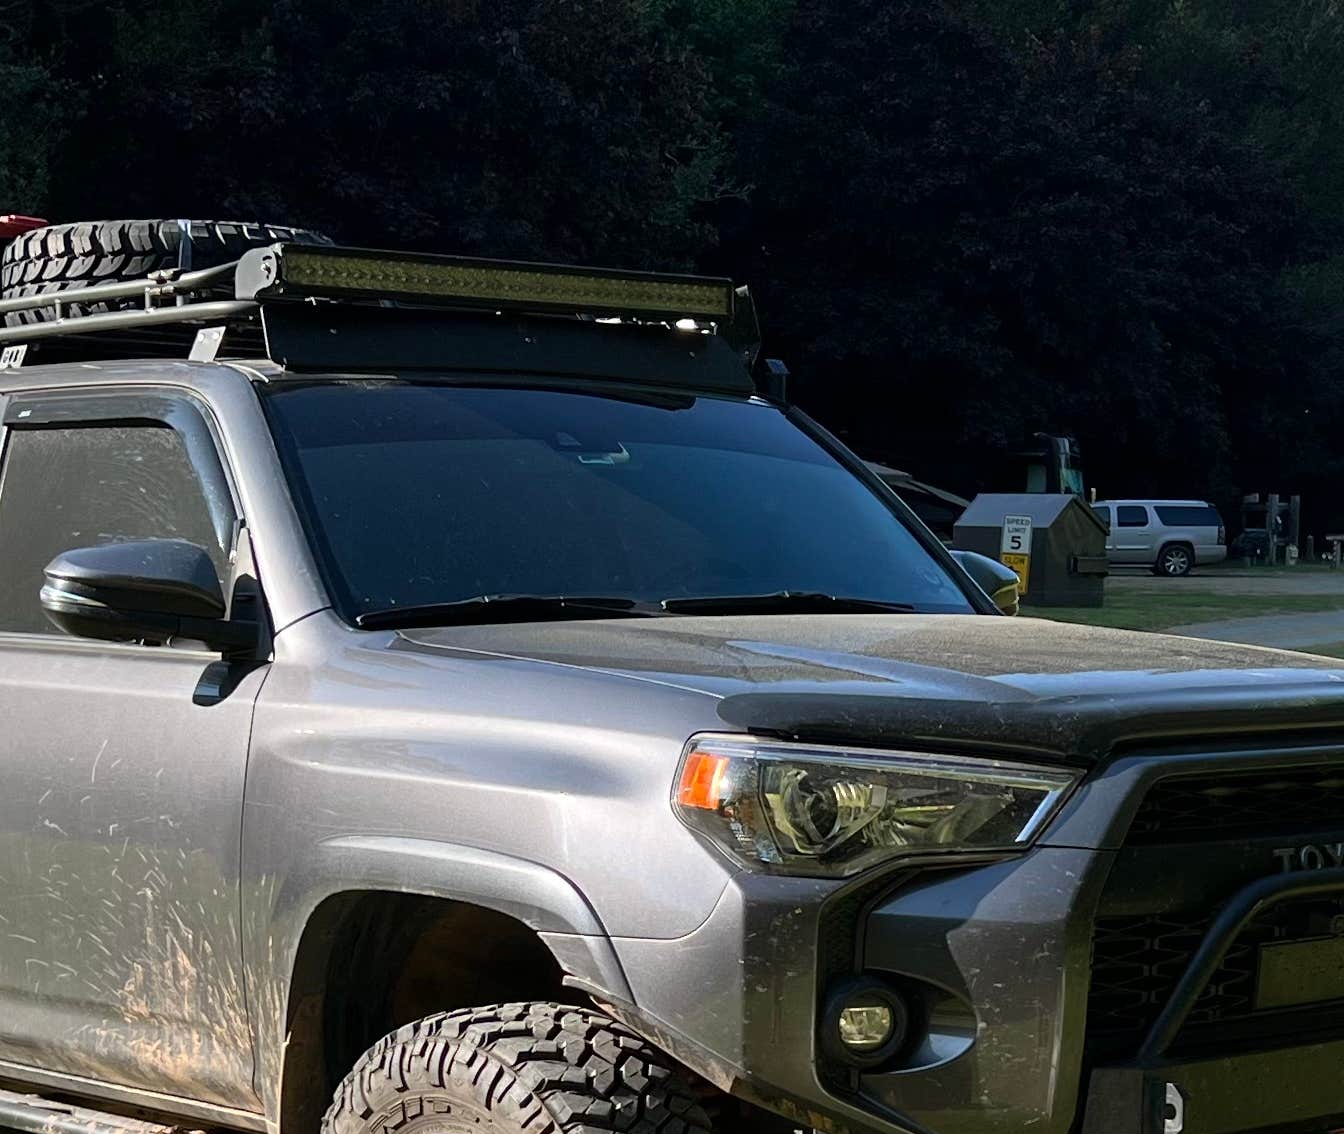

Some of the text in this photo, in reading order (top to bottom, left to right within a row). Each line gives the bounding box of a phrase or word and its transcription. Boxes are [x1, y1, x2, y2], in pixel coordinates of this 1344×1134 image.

[1006, 517, 1031, 526] SPEED
[1007, 526, 1027, 534] LIMIT
[1010, 535, 1022, 550] 5
